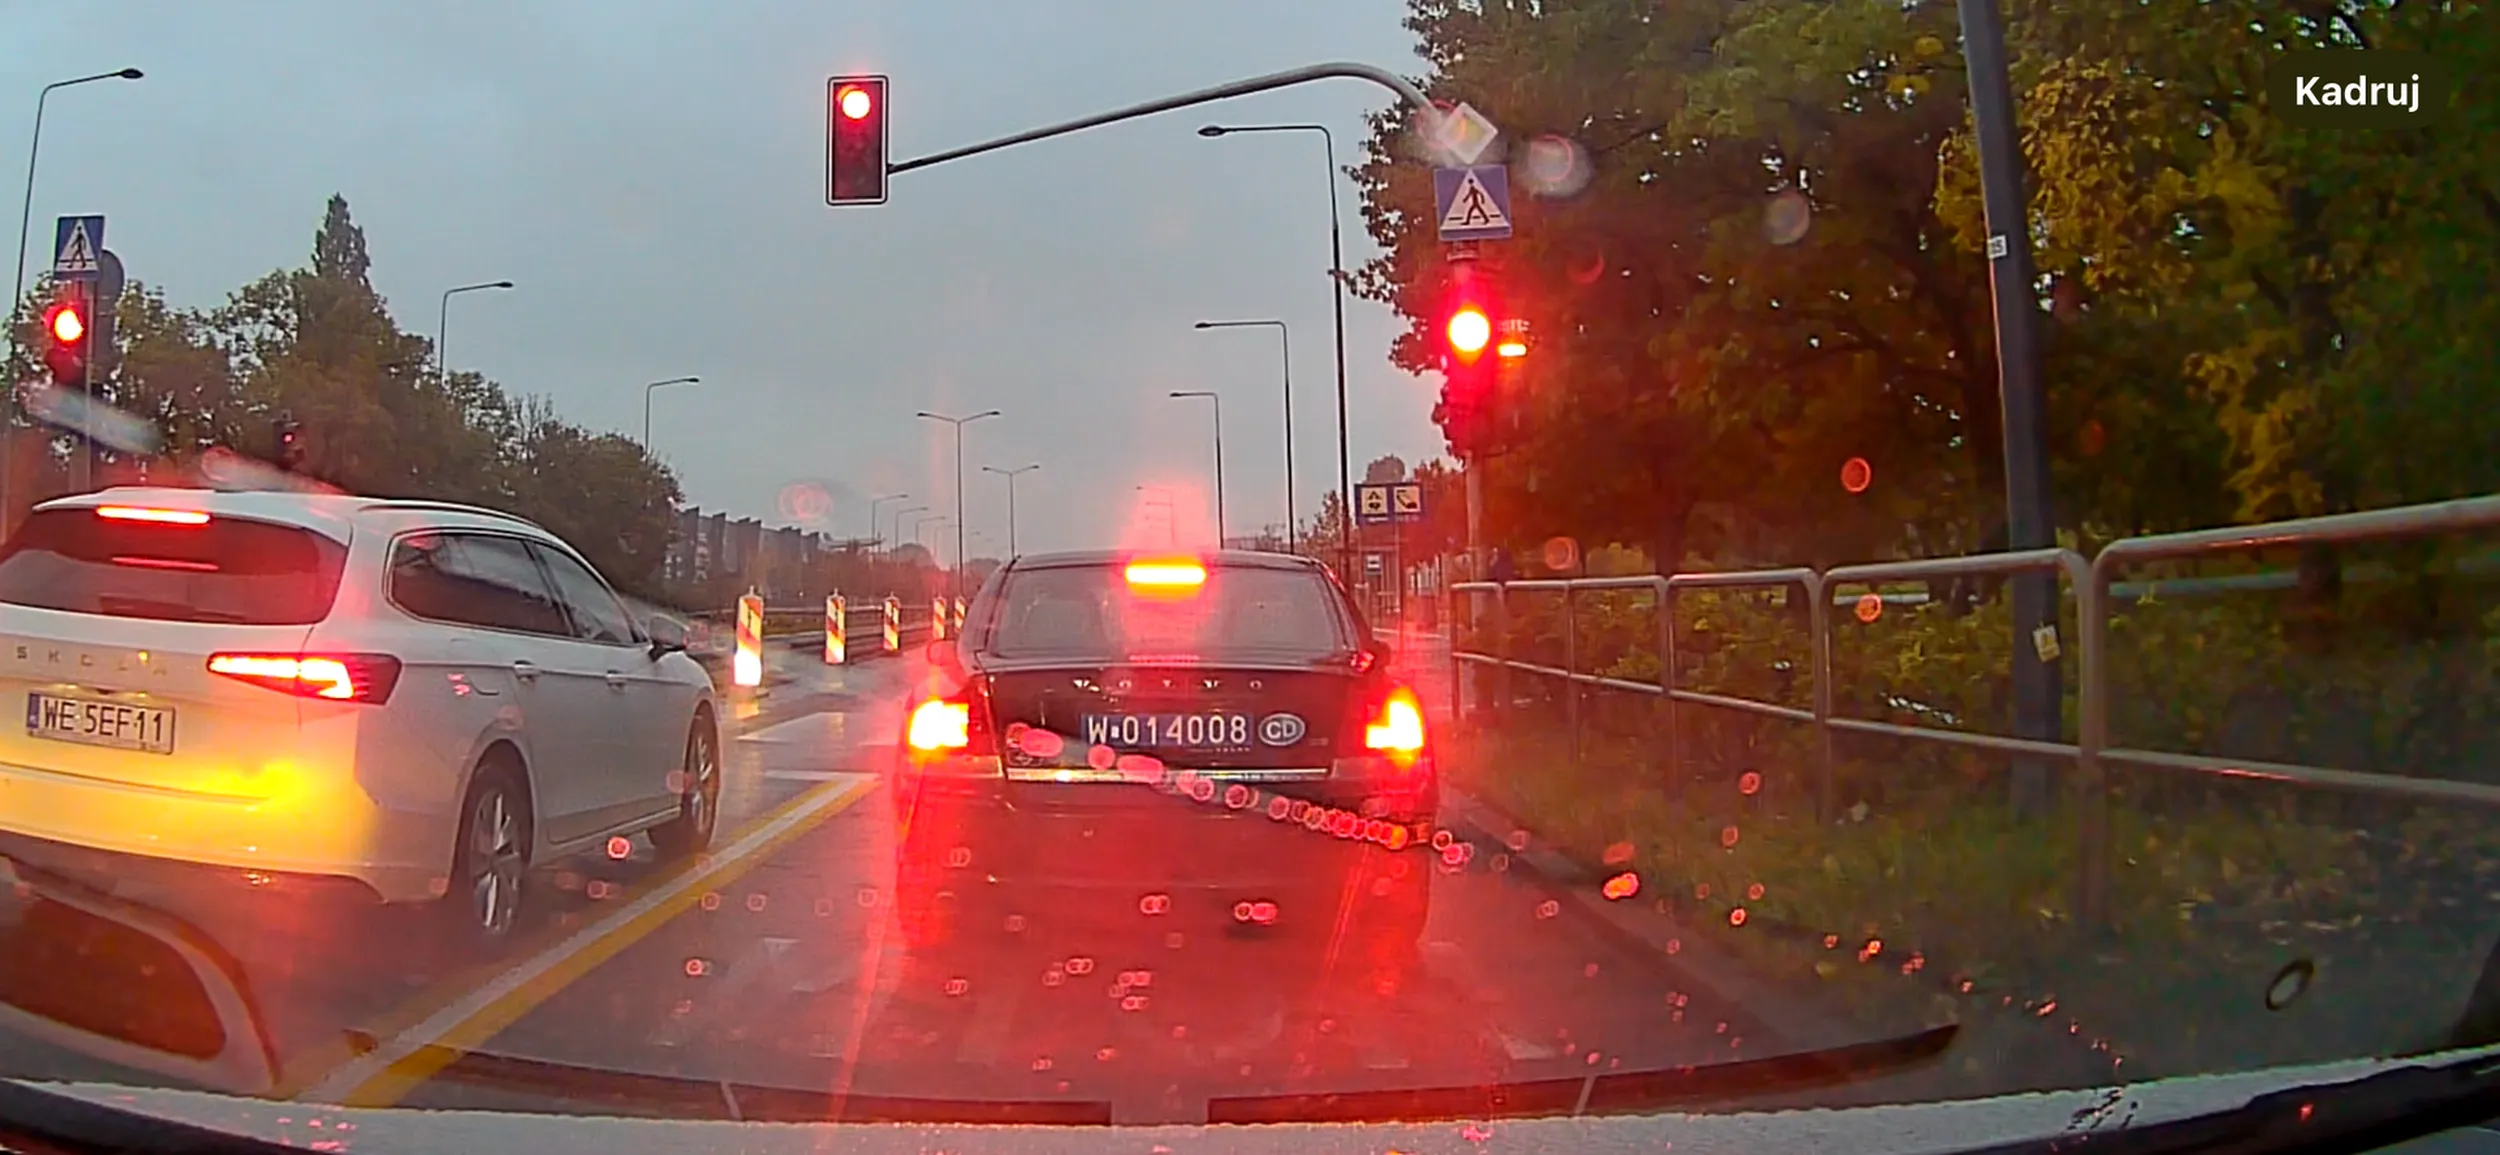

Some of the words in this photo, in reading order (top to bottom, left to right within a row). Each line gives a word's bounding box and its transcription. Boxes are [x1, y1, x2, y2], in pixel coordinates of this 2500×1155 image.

[44, 699, 76, 731] WE
[84, 704, 162, 742] 5EF11
[1088, 715, 1107, 745] W
[1122, 714, 1246, 745] 014008
[1266, 720, 1297, 739] CD
